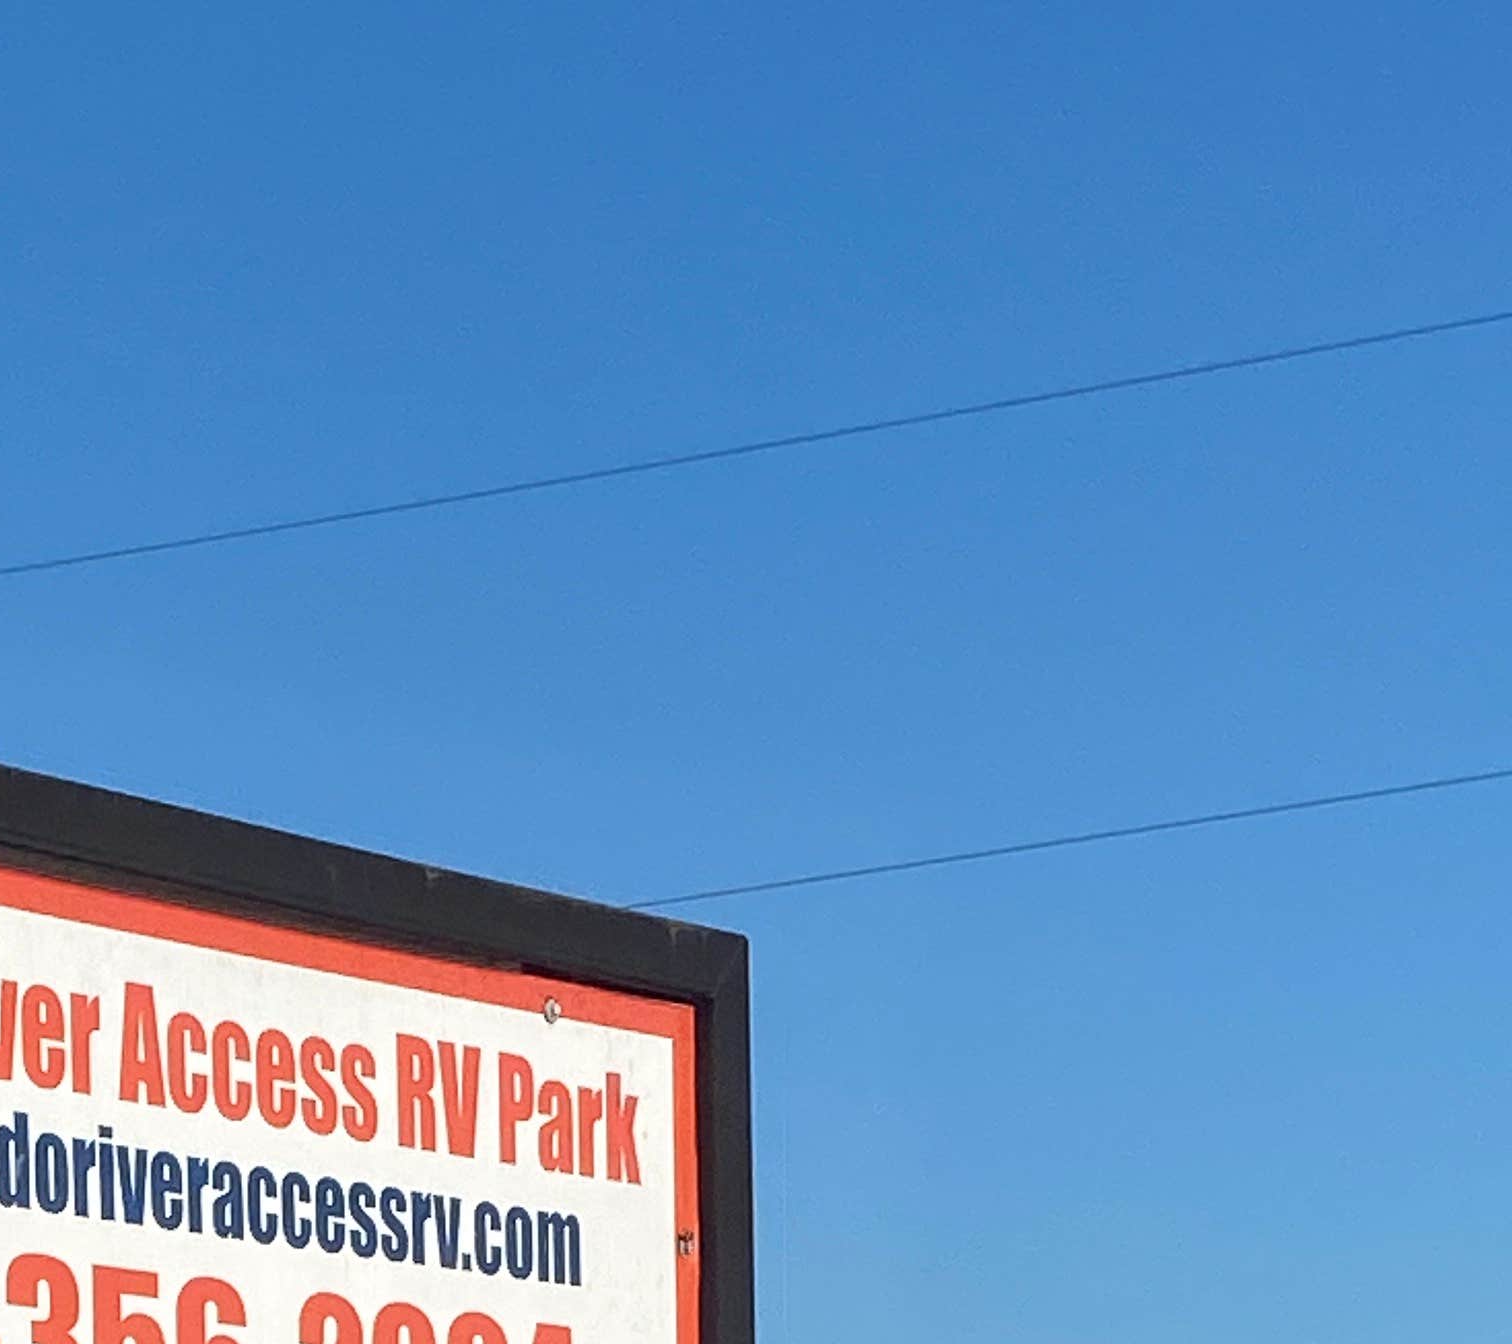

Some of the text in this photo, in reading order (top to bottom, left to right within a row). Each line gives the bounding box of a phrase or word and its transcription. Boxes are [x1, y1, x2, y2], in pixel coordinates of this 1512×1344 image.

[120, 982, 377, 1141] Access
[397, 1034, 480, 1158] RV
[499, 1052, 640, 1184] Park
